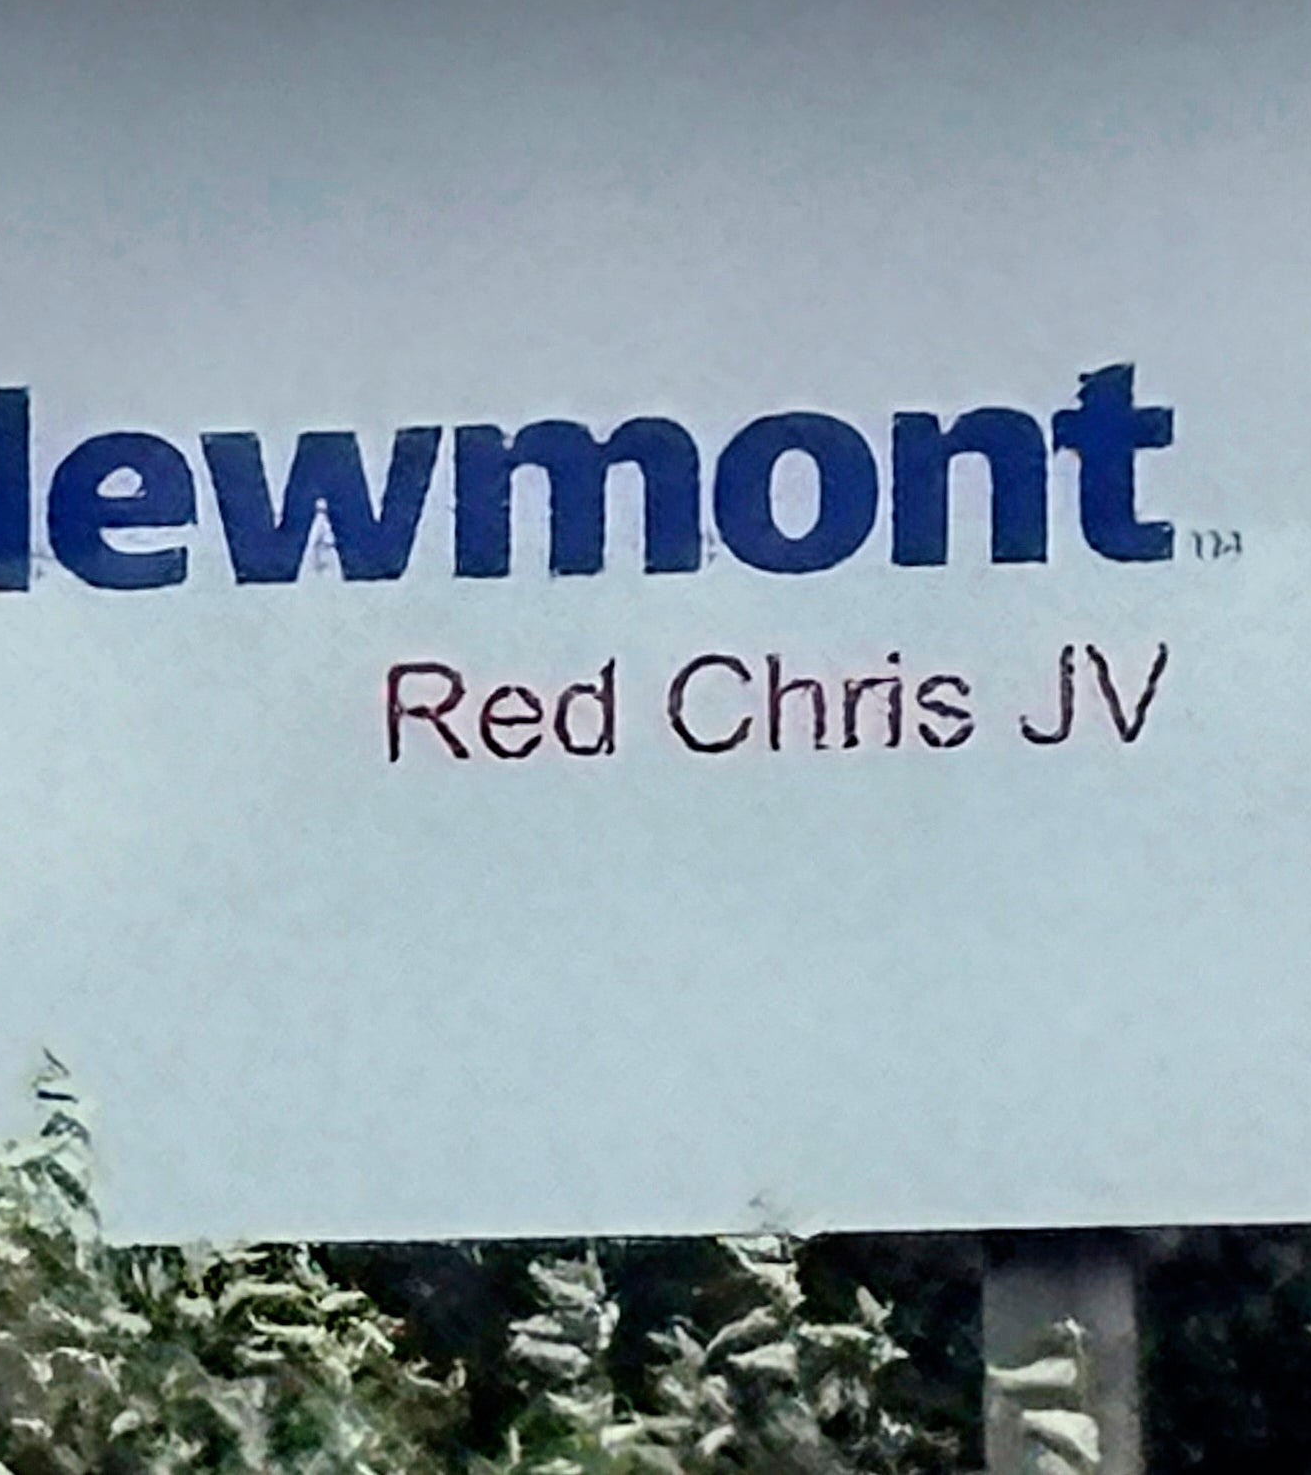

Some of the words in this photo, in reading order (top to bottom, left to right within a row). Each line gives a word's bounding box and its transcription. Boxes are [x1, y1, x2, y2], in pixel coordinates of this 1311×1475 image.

[387, 657, 616, 763] Red
[667, 651, 975, 755] Chris
[1019, 642, 1171, 746] JV
